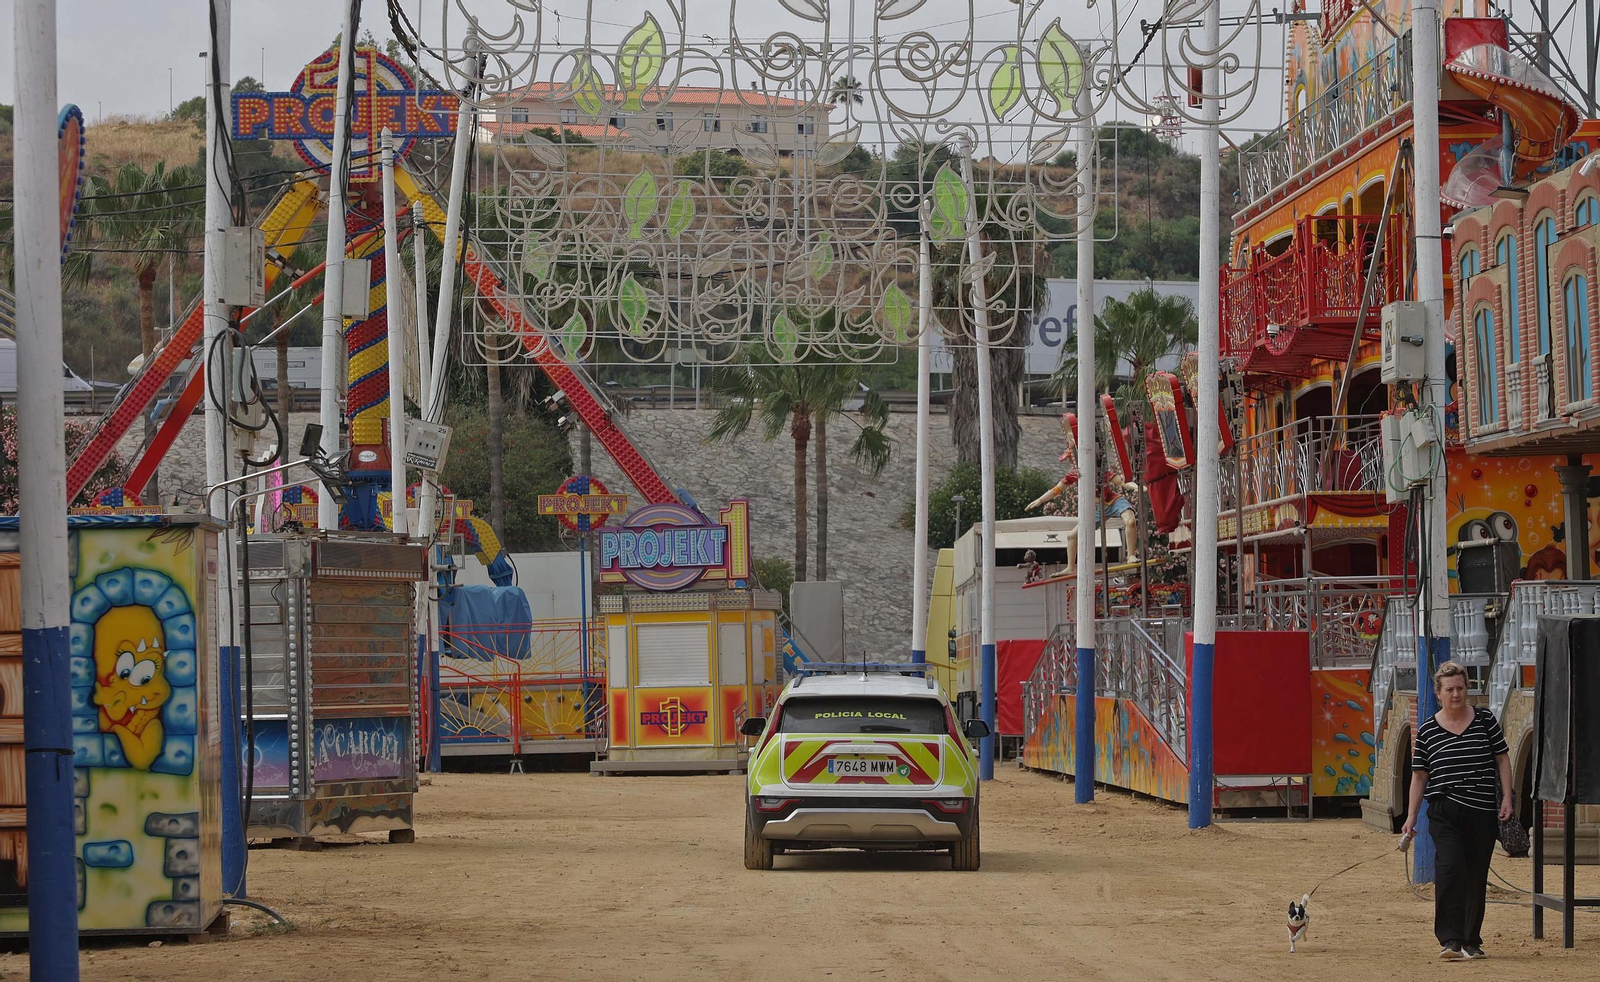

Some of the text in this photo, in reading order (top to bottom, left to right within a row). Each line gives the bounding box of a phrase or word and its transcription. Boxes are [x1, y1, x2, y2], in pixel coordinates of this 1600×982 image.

[539, 496, 627, 513] PROJEKT
[601, 501, 748, 579] PROJEKT 1
[641, 711, 707, 725] PROJEKT
[660, 697, 680, 737] 1
[814, 711, 907, 720] POLICIA LOCAL
[836, 761, 894, 772] 7648 MWM
